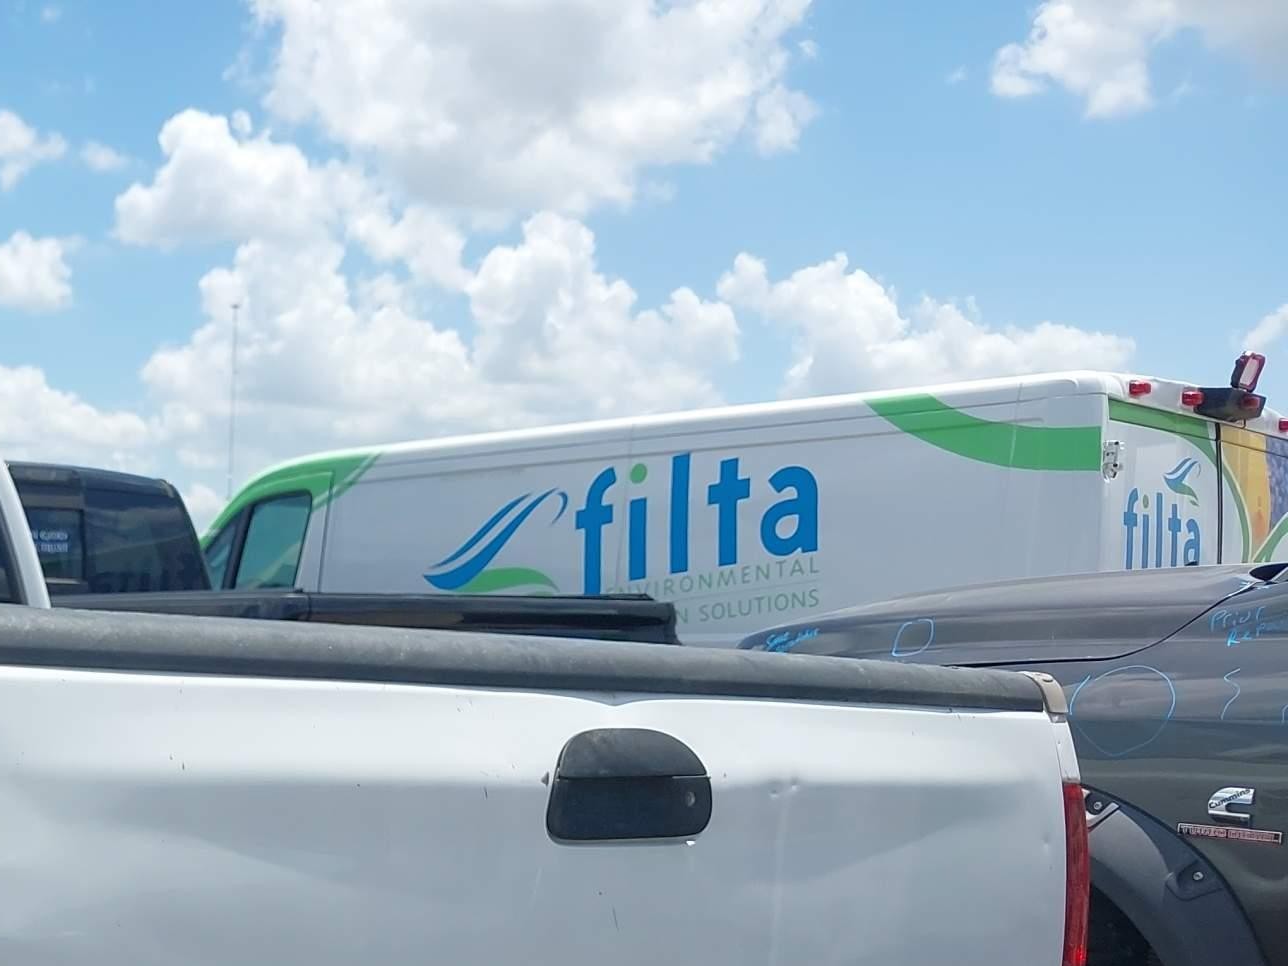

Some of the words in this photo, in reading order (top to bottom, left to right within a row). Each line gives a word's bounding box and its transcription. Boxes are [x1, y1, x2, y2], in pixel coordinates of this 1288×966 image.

[575, 452, 819, 595] filta
[1123, 487, 1201, 569] filta
[699, 589, 819, 623] SOLUTIONS
[1208, 788, 1252, 810] Cummins
